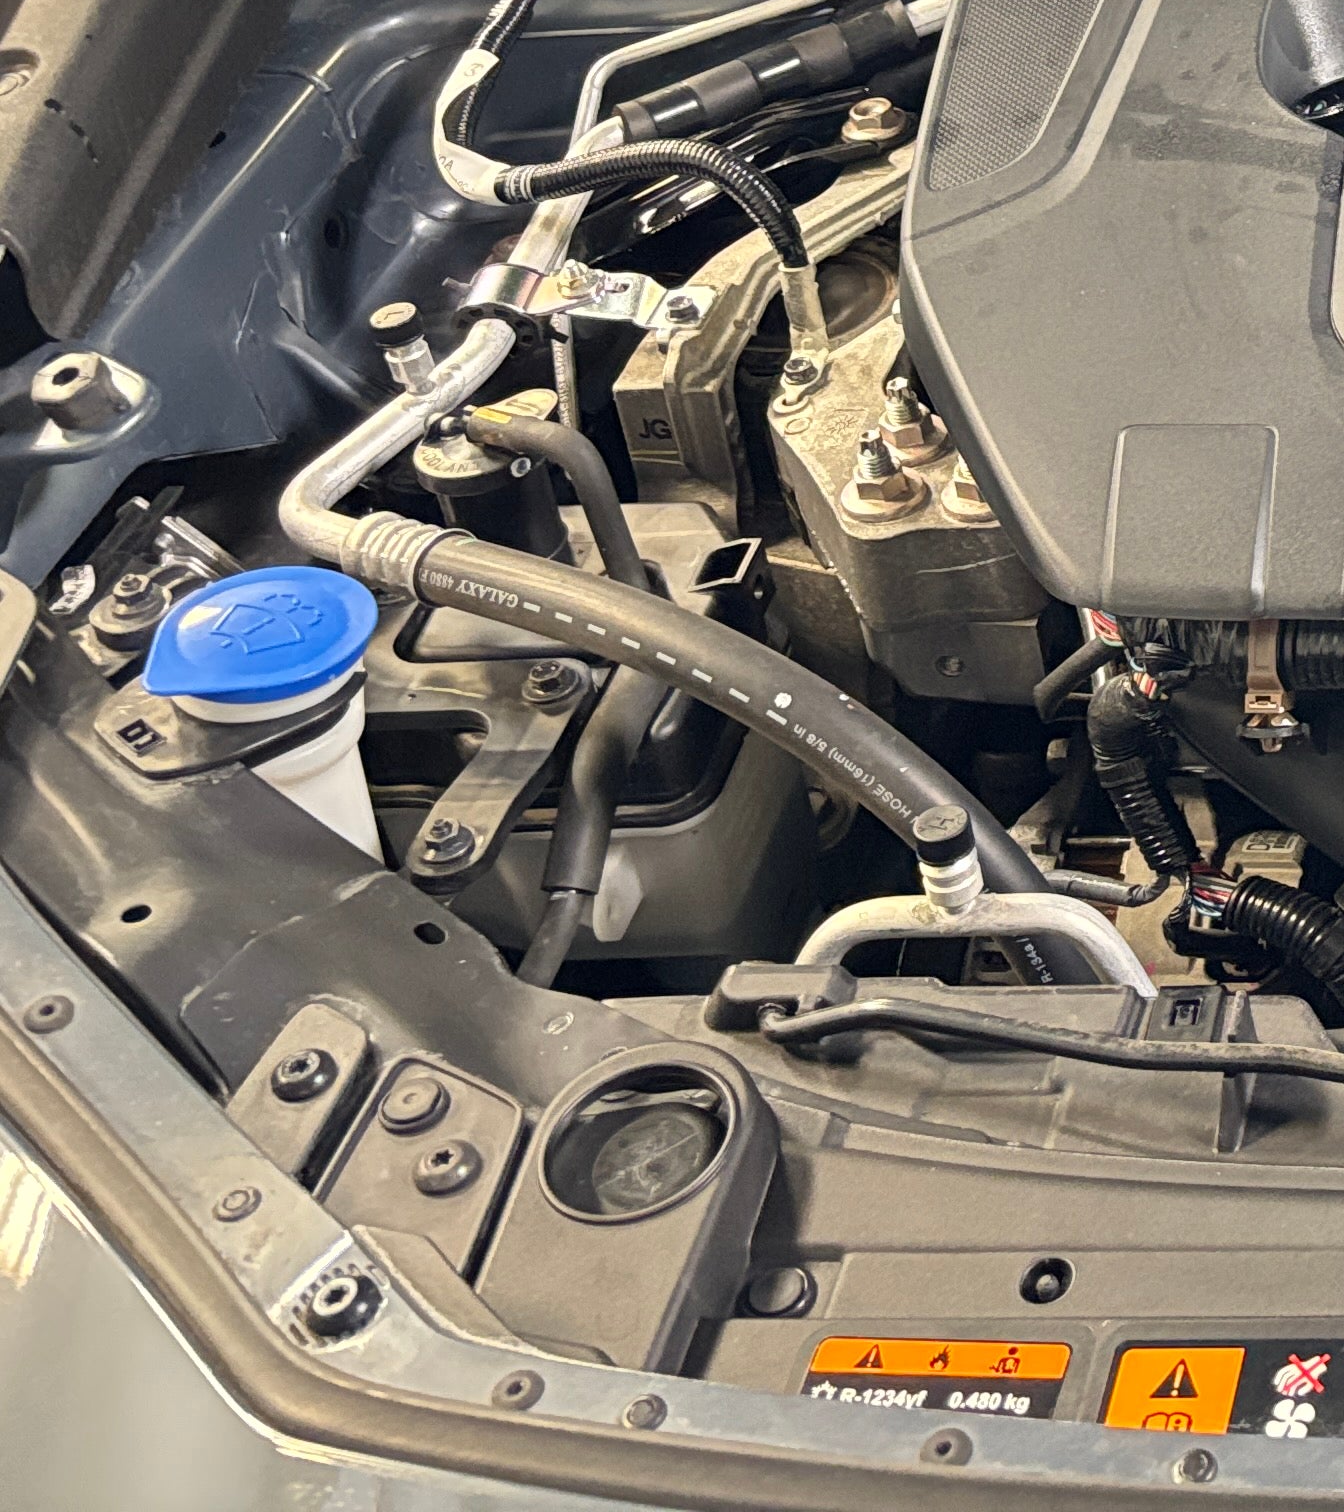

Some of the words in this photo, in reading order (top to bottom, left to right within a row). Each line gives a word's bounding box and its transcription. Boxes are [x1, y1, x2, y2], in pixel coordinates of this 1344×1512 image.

[455, 579, 519, 608] GALAXY
[805, 733, 828, 753] 5/8
[828, 746, 875, 786] (16mm)
[872, 783, 912, 818] HOSE
[840, 1388, 928, 1409] R-1234yf
[949, 1391, 1000, 1410] 0.480
[1004, 1392, 1031, 1414] kg
